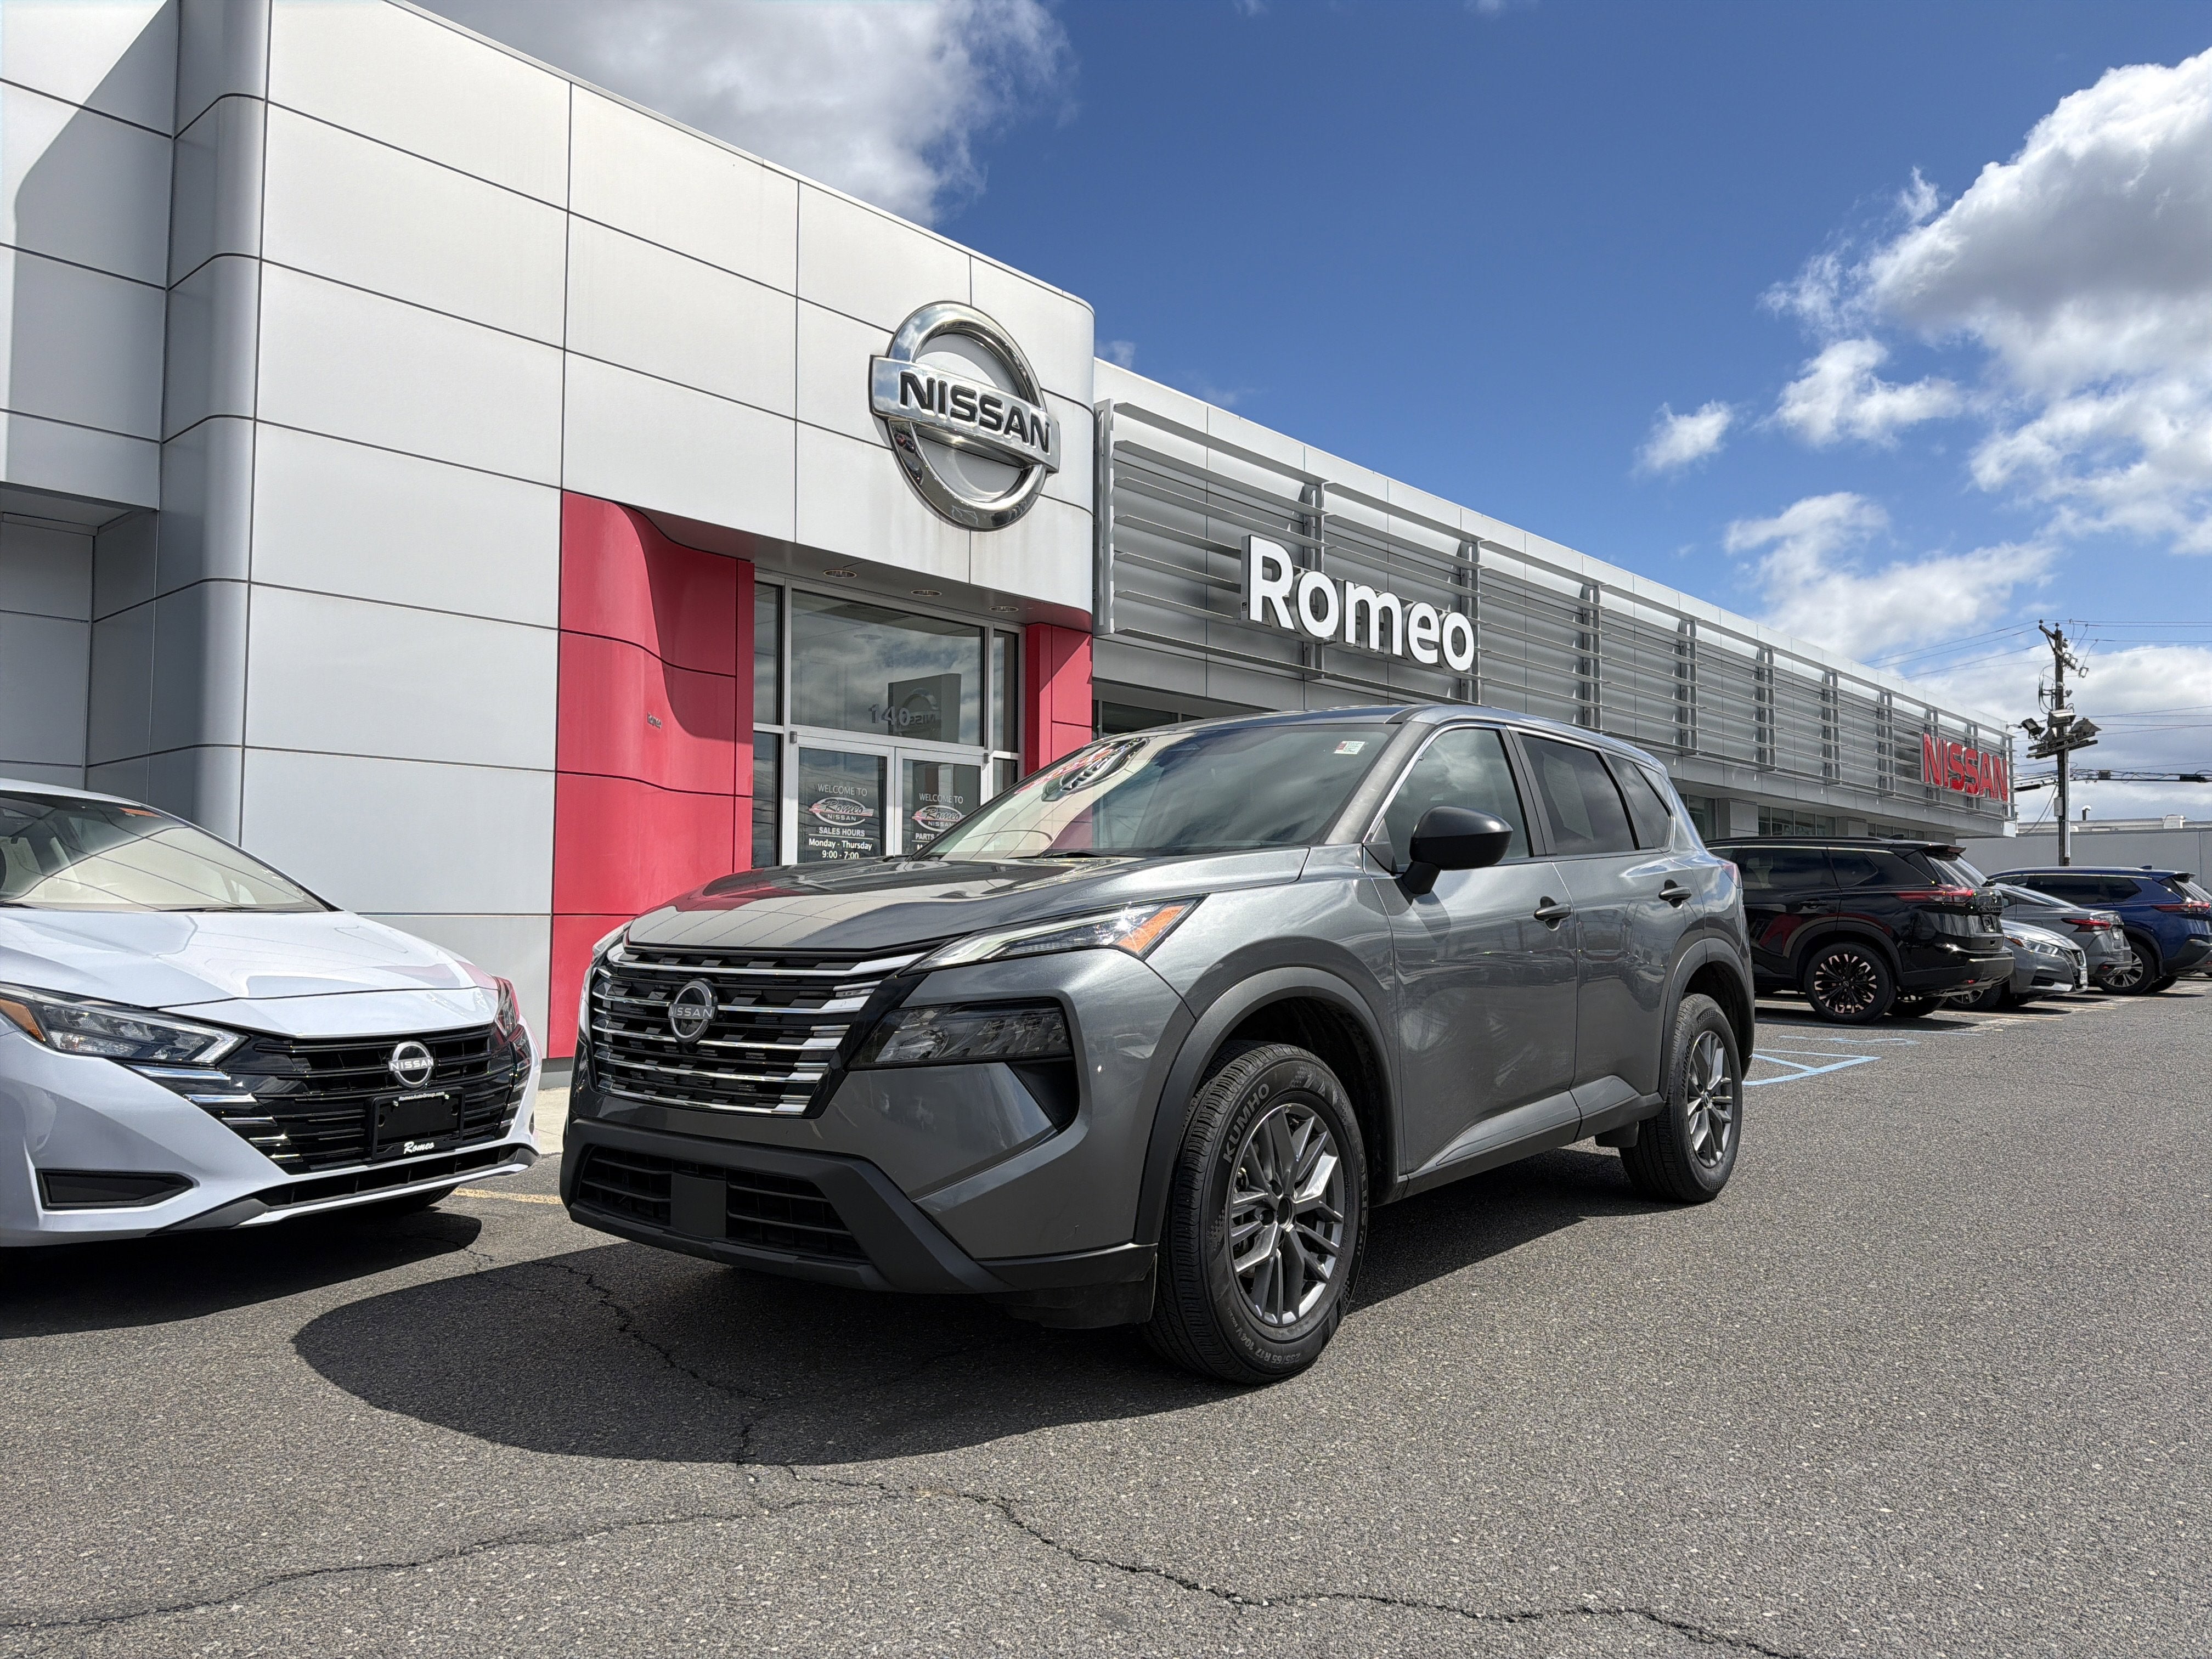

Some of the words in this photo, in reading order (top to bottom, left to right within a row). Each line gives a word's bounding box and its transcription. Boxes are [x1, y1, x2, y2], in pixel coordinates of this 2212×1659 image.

[899, 370, 1051, 456] NISSAN
[1242, 533, 1476, 673] Romeo
[870, 704, 910, 726] 140
[1921, 732, 2008, 803] NISSAN
[817, 783, 856, 795] WELCOME
[856, 787, 867, 797] TO
[919, 793, 953, 803] WELCOME
[953, 795, 963, 804] TO
[823, 799, 864, 815] Romeo
[923, 806, 960, 821] Romeo
[819, 827, 840, 835] SALES
[842, 828, 865, 837] HOURS
[809, 838, 836, 849] Monday
[842, 840, 872, 851] Thursday
[822, 850, 838, 859] 9:00
[844, 851, 859, 860] 7:00
[669, 1006, 713, 1018] NISSAN
[390, 1058, 434, 1071] NISSAN
[398, 1091, 445, 1102] RomeoAutoGroup.com
[1223, 1084, 1269, 1164] KUMHO
[403, 1141, 435, 1154] Romeo
[1255, 1348, 1272, 1362] R17
[1271, 1352, 1301, 1364] 235/65
